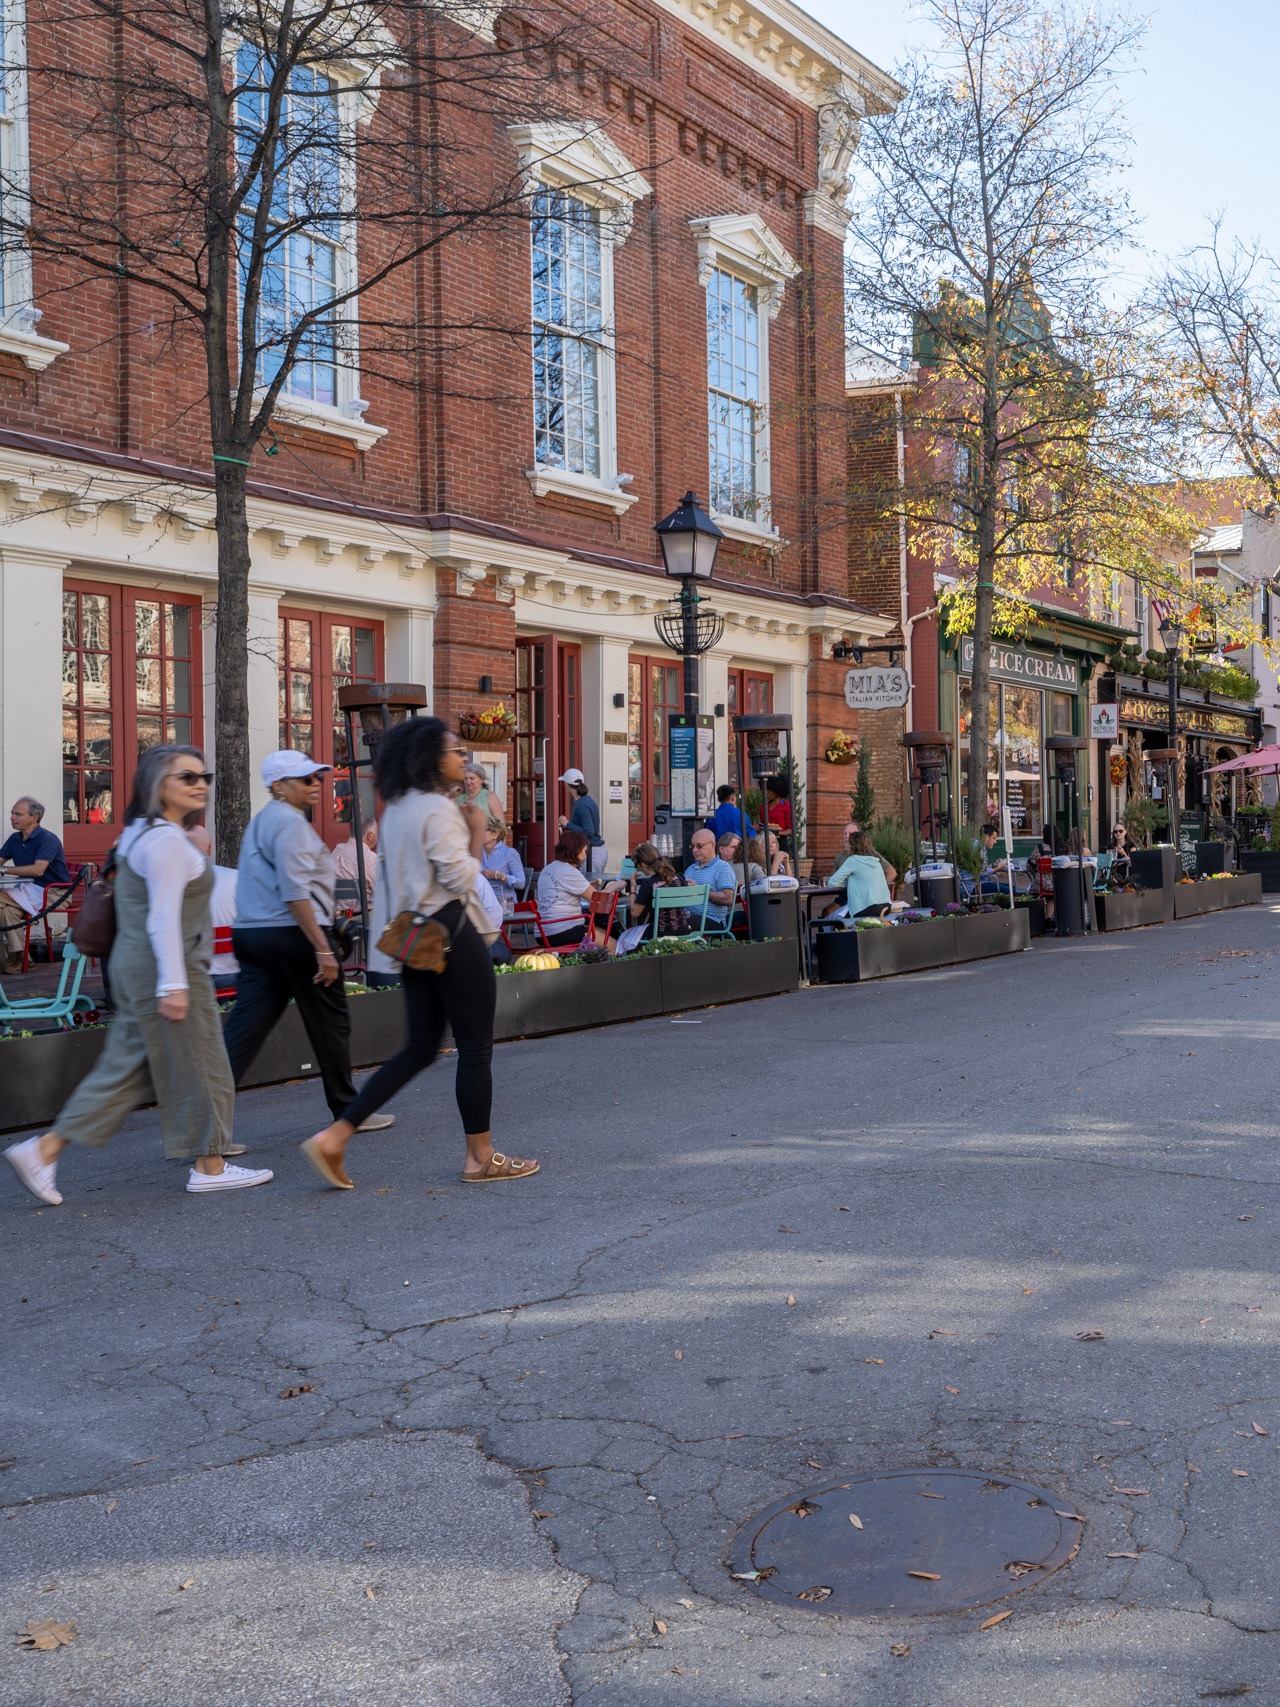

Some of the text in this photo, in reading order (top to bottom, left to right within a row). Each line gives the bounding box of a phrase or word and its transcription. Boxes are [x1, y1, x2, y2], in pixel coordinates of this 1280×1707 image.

[999, 651, 1023, 673] ICE
[1025, 657, 1076, 683] CREAM
[849, 674, 903, 693] MIA'S
[1134, 702, 1215, 728] O'CONELL'S
